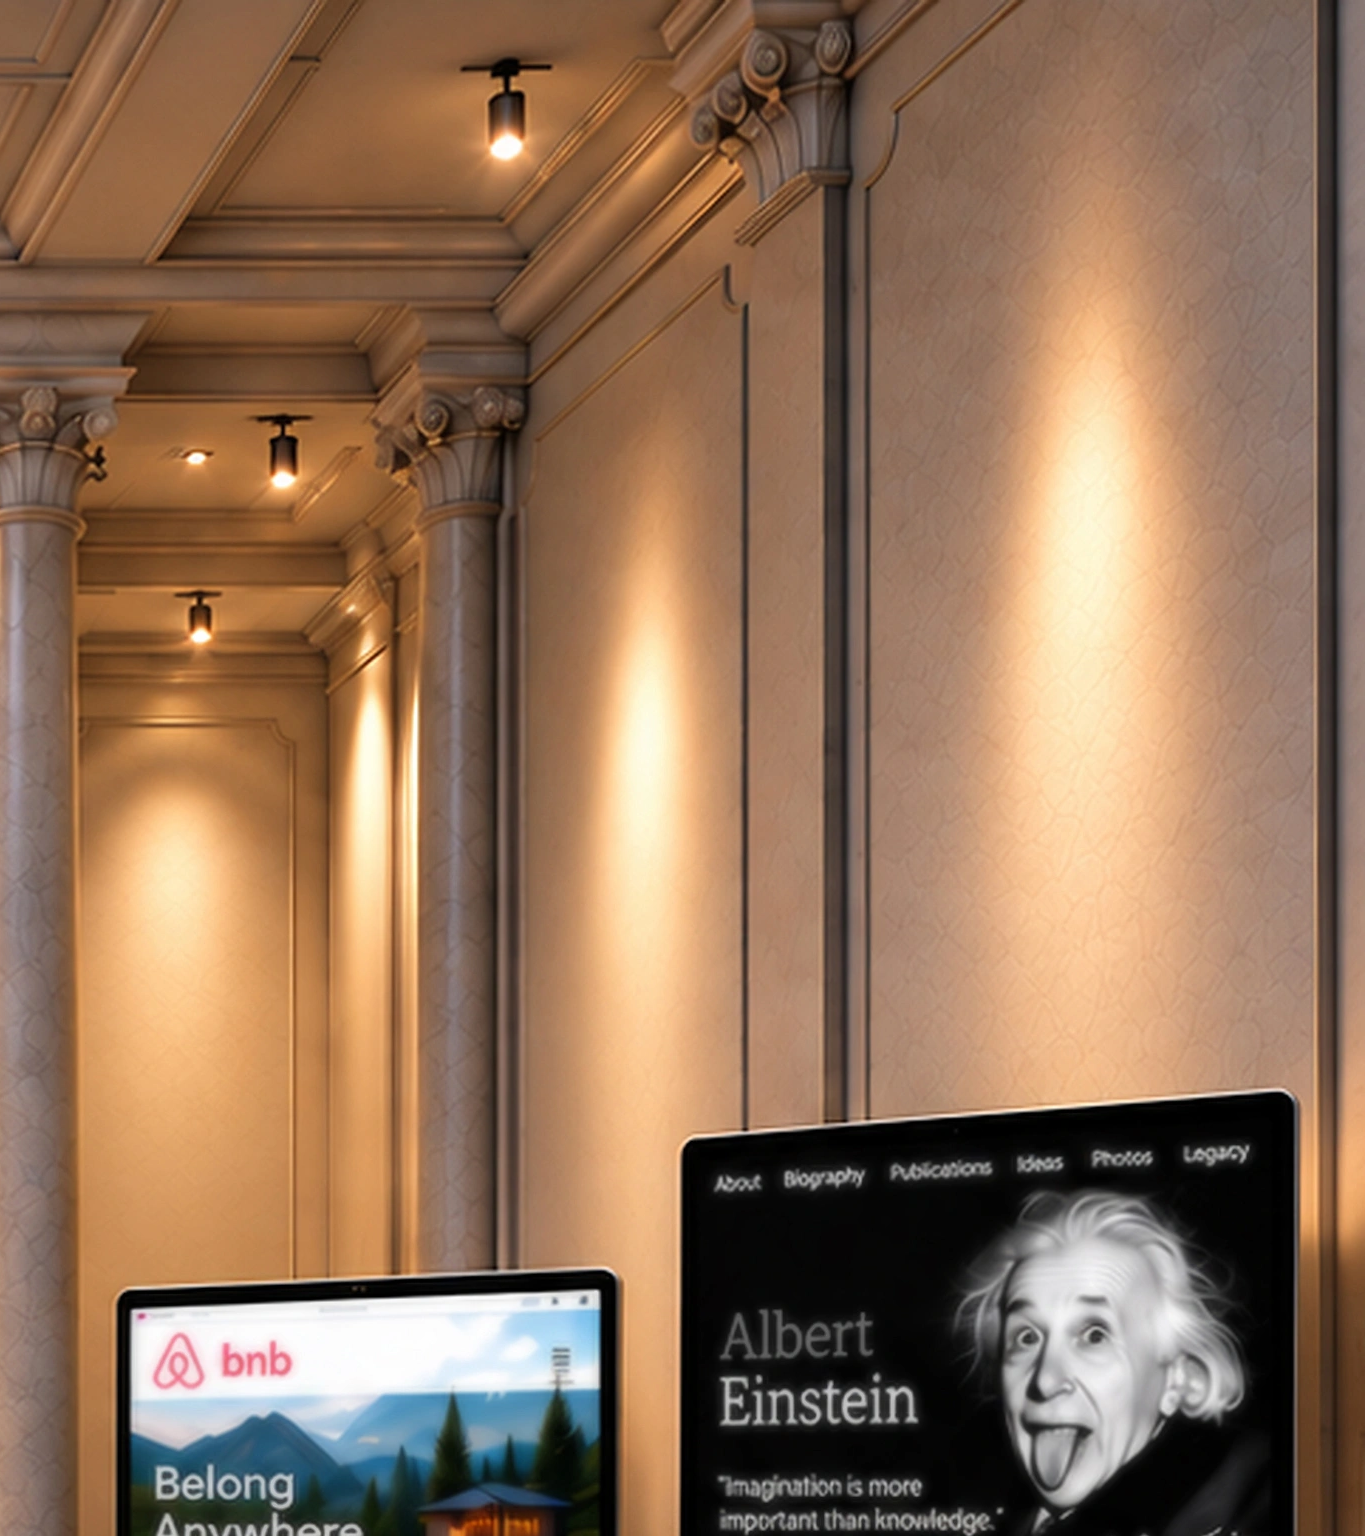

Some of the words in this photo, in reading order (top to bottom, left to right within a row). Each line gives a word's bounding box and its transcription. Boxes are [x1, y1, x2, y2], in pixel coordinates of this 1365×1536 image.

[714, 1175, 761, 1192] About
[784, 1167, 865, 1190] Biography
[890, 1160, 993, 1181] Publications
[1017, 1155, 1064, 1172] Ideas
[1092, 1150, 1153, 1167] Photos
[1184, 1145, 1250, 1166] Legacy
[720, 1309, 873, 1360] Albert
[221, 1341, 293, 1377] bnb
[720, 1373, 918, 1426] Einstein
[155, 1464, 295, 1510] Belong
[847, 1475, 863, 1497] is
[869, 1479, 922, 1497] more
[720, 1510, 819, 1535] important
[824, 1509, 870, 1530] than
